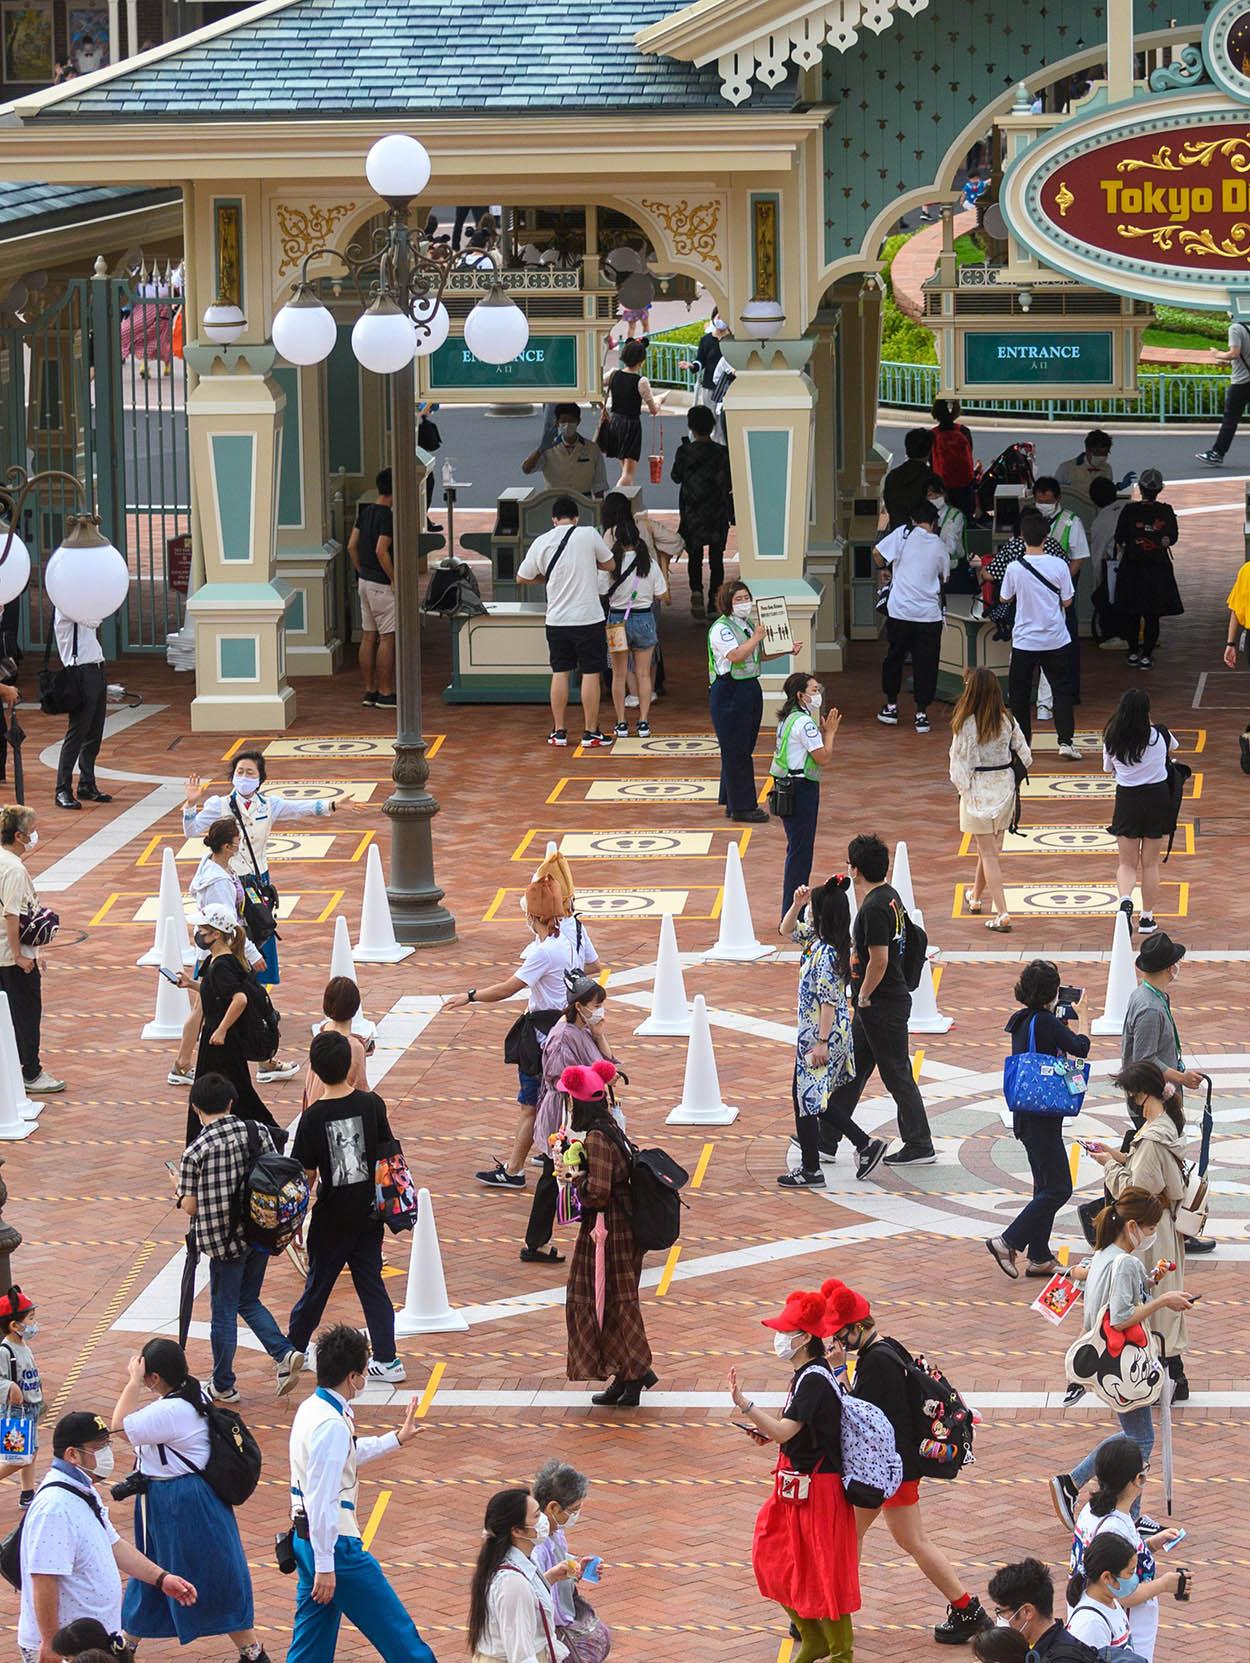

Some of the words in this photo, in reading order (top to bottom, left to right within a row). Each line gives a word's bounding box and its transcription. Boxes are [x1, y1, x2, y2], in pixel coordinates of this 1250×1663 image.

[1100, 180, 1213, 222] Tokyo
[462, 350, 545, 362] ENCE
[998, 346, 1081, 358] ENTRANCE
